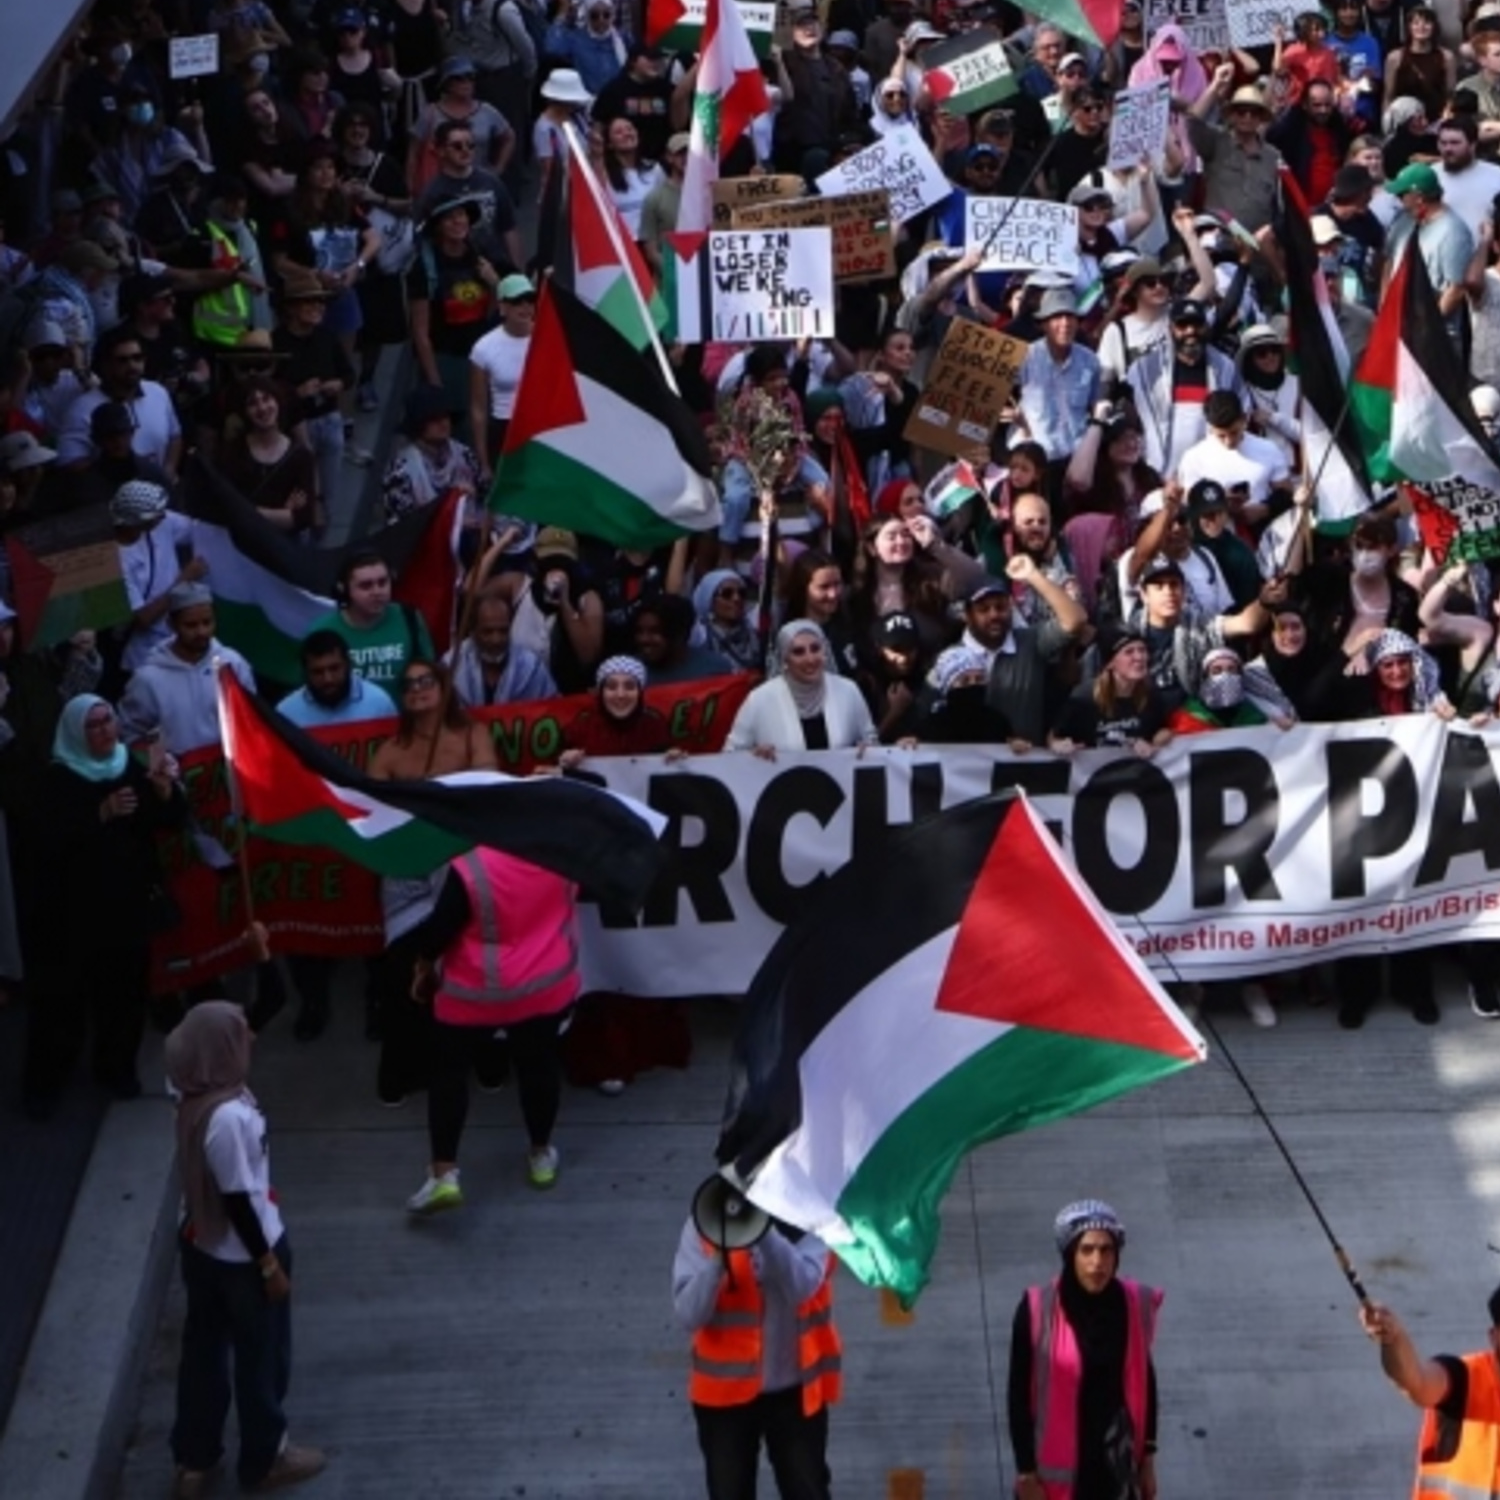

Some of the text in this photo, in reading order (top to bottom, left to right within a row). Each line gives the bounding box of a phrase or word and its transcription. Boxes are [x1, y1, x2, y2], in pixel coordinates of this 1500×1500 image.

[951, 53, 992, 75] FREE
[736, 177, 782, 196] FREE
[970, 200, 1077, 227] CHILDREN
[711, 231, 790, 252] GET IN
[714, 250, 789, 273] LOSER
[982, 239, 1058, 267] PEACE
